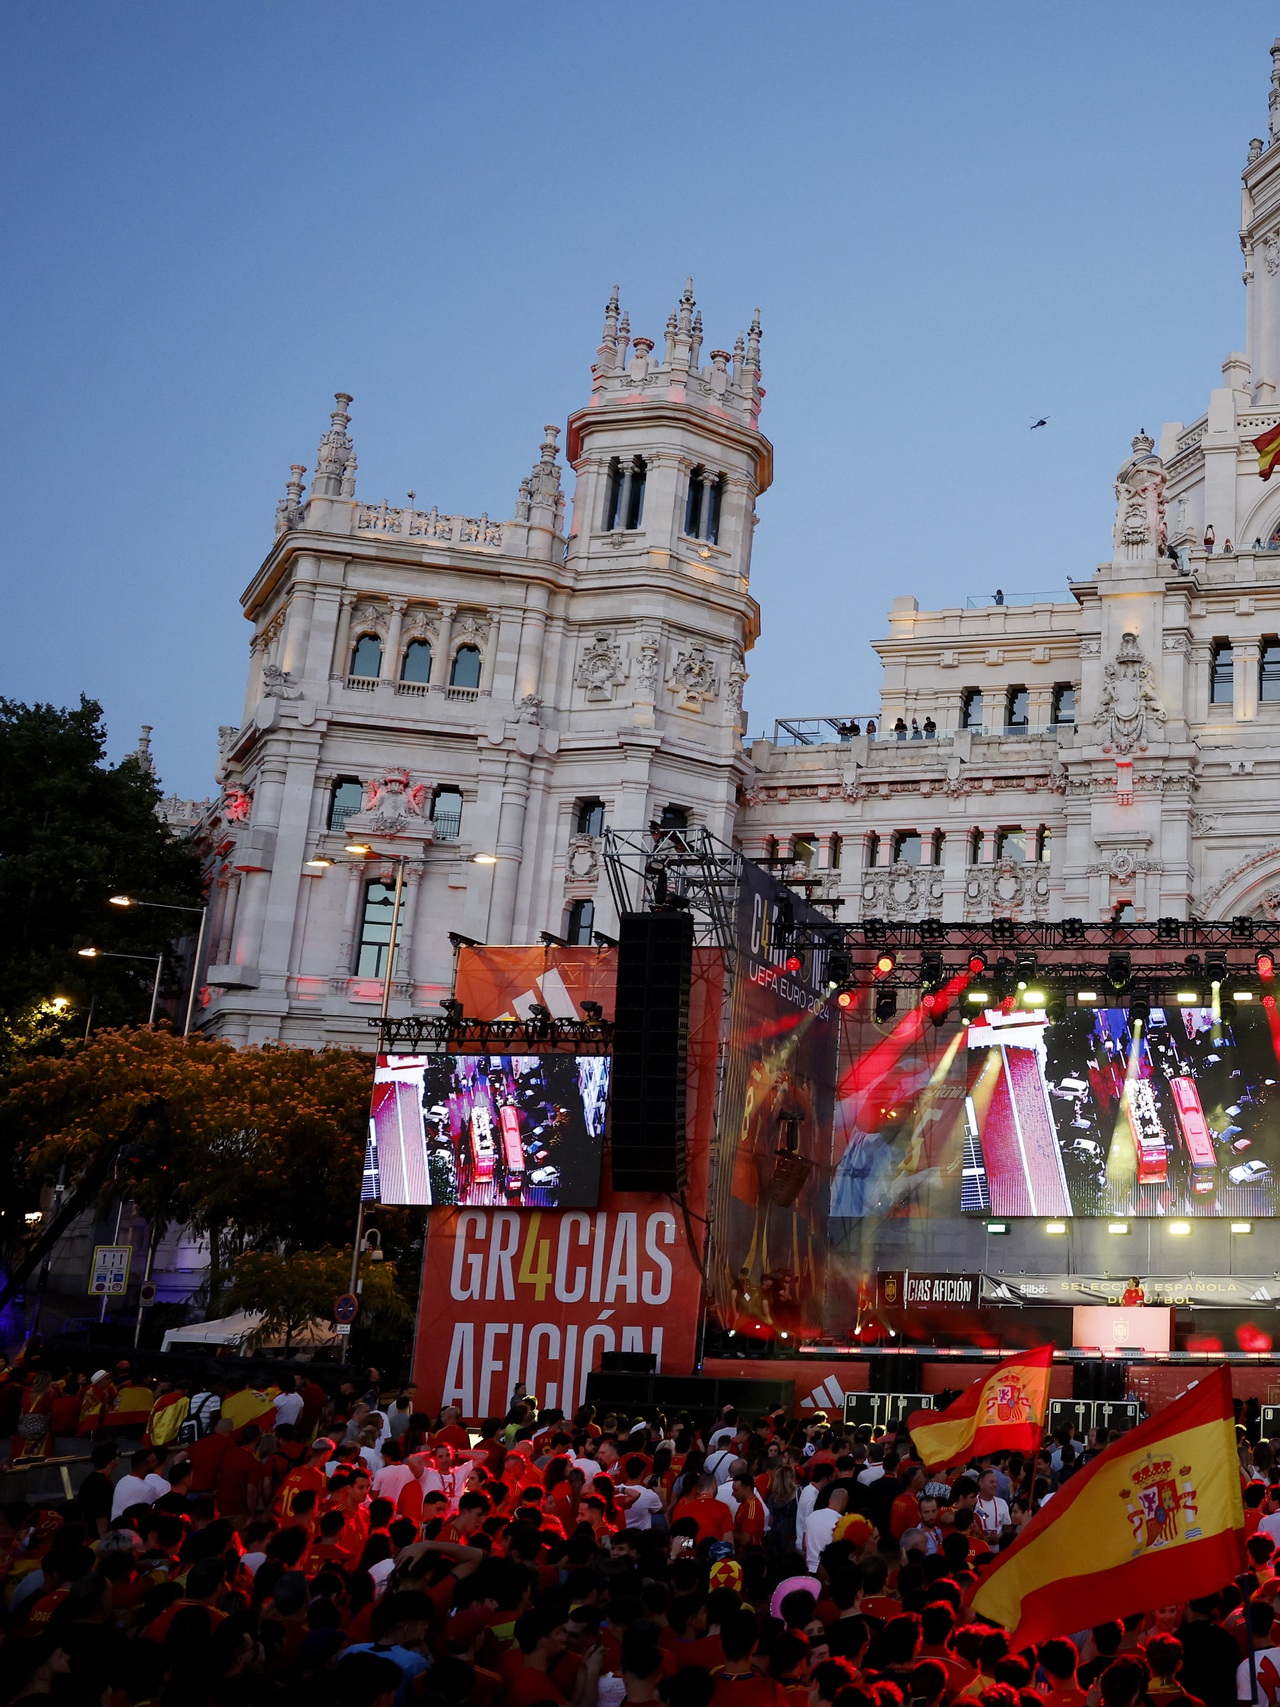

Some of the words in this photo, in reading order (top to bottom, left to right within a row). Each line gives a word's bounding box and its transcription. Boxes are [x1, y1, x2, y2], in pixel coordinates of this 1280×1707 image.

[749, 960, 778, 994] UEFA
[780, 978, 807, 1009] EURO
[807, 995, 830, 1022] 2024
[451, 1210, 676, 1305] GR4CIAS
[932, 1277, 972, 1302] AFICIÓN
[1060, 1282, 1149, 1292] SELECCIN
[1154, 1281, 1237, 1292] ESPAÑOLA
[1143, 1294, 1194, 1305] ÚTBOL
